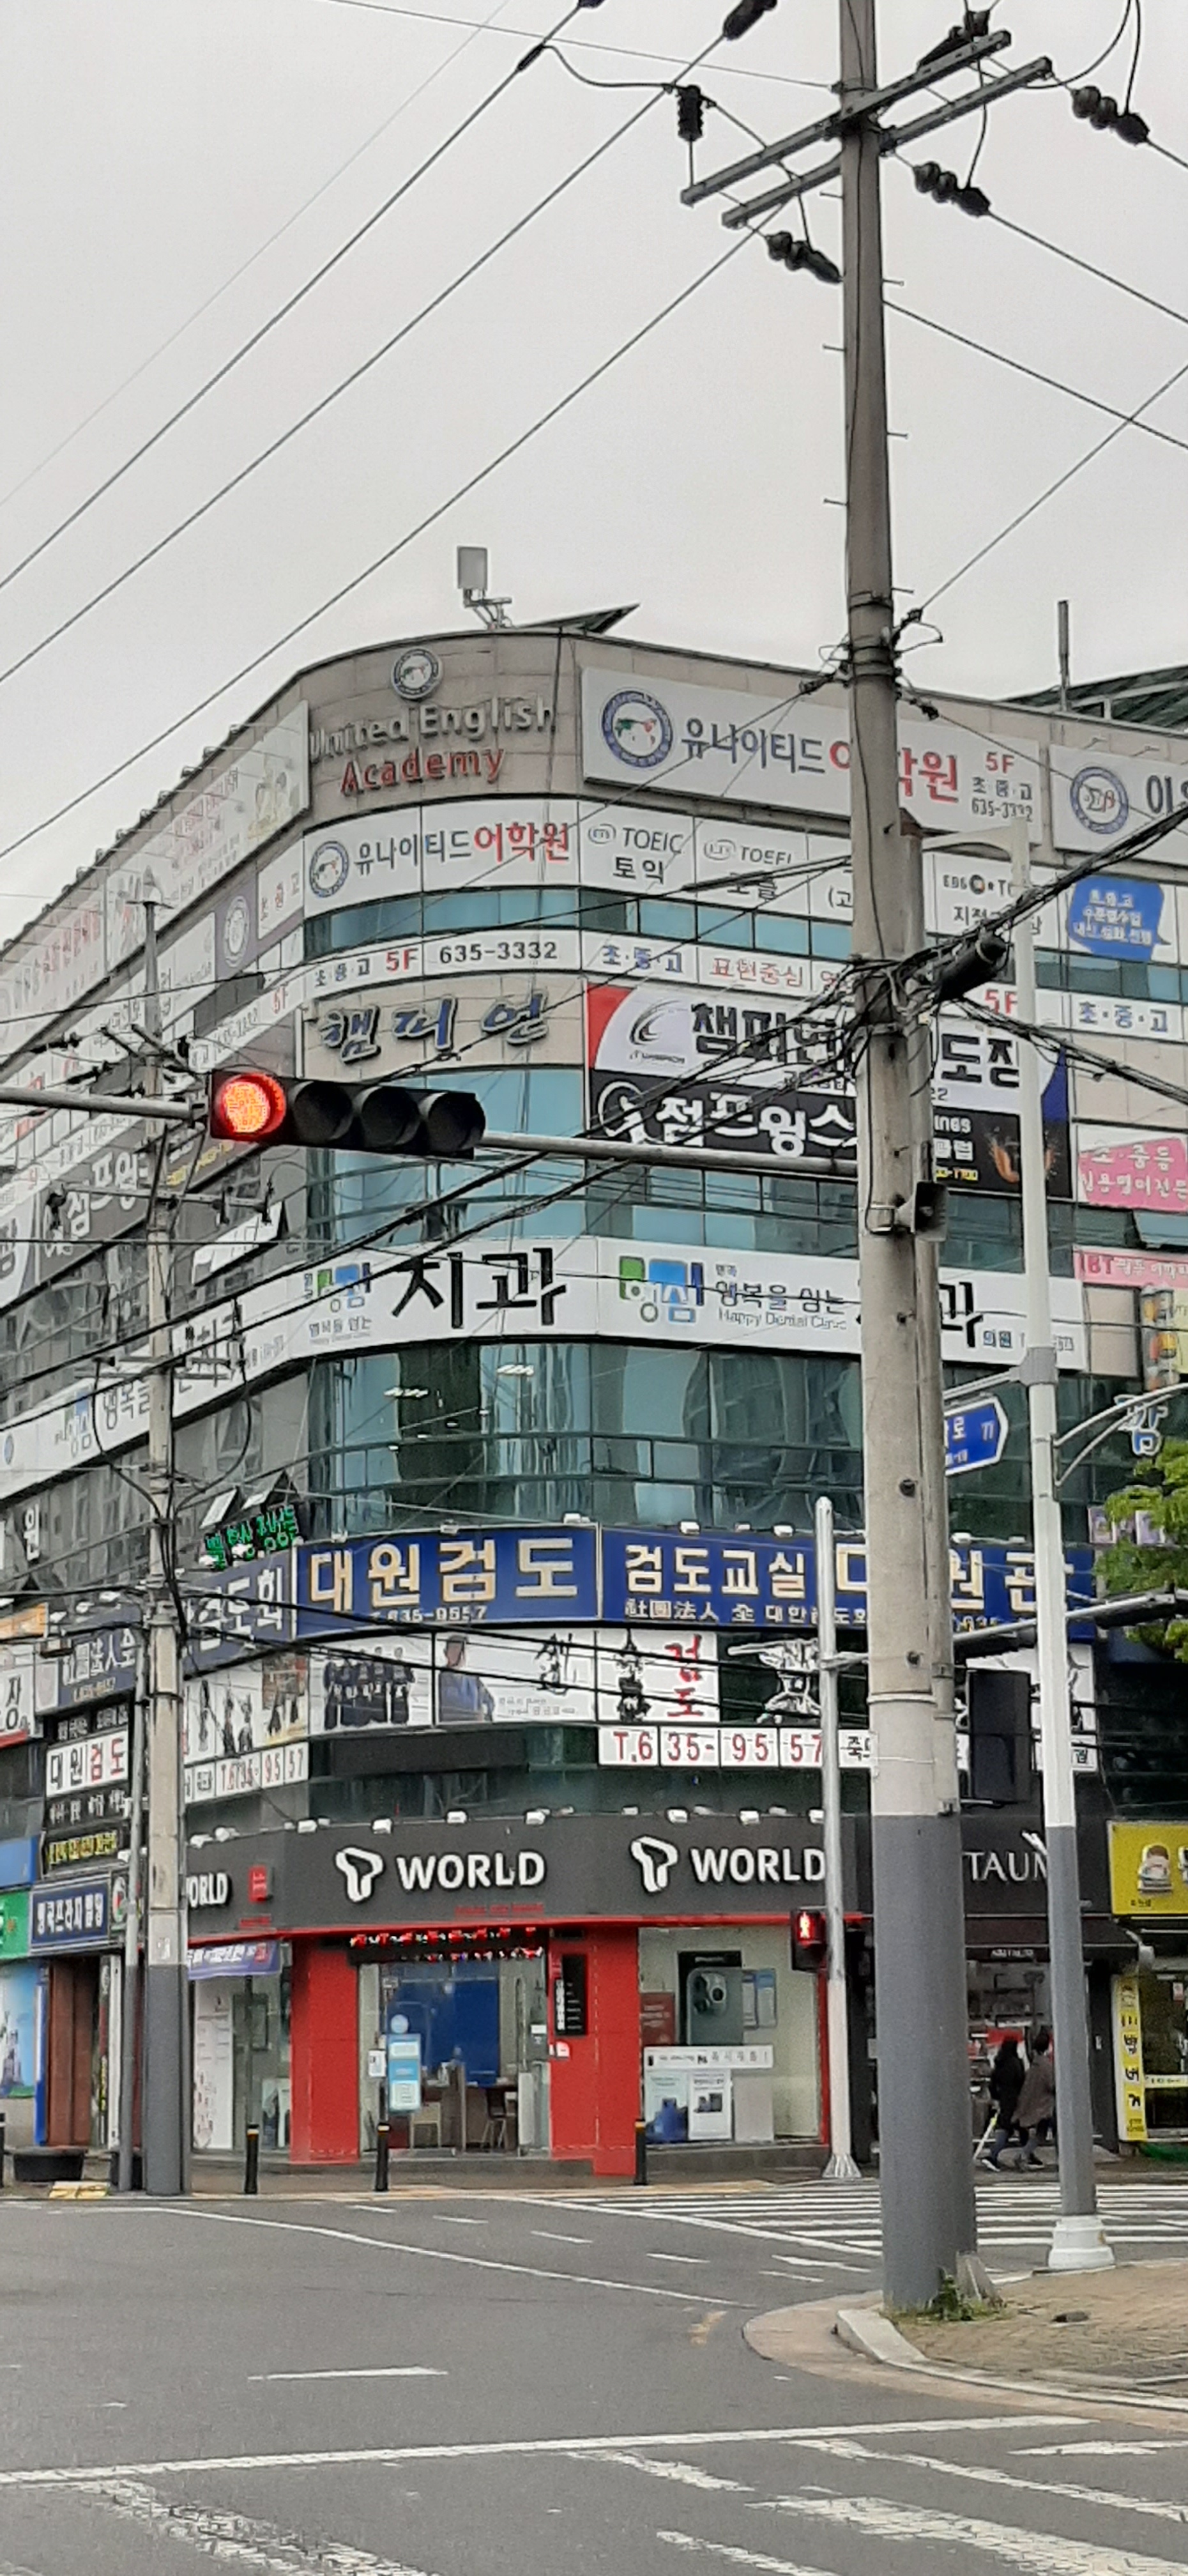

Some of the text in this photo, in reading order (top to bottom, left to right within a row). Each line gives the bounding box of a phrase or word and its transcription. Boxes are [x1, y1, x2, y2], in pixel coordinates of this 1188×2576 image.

[309, 707, 410, 763] United
[419, 694, 554, 740] English
[341, 746, 504, 797] Academy
[986, 751, 1015, 774] 5F
[622, 827, 684, 854] TOEIC
[613, 856, 665, 884] 토익
[386, 948, 419, 972] 5F
[439, 941, 558, 964] 635-3332
[709, 957, 803, 987] 표현중심
[391, 1247, 567, 1330] 치과
[980, 1419, 996, 1442] 77
[310, 1537, 578, 1612] 대원검도
[625, 1544, 806, 1598] 검도교실
[396, 1851, 545, 1891] WORLD
[690, 1848, 826, 1883] WORLD
[186, 1871, 229, 1908] ORLD
